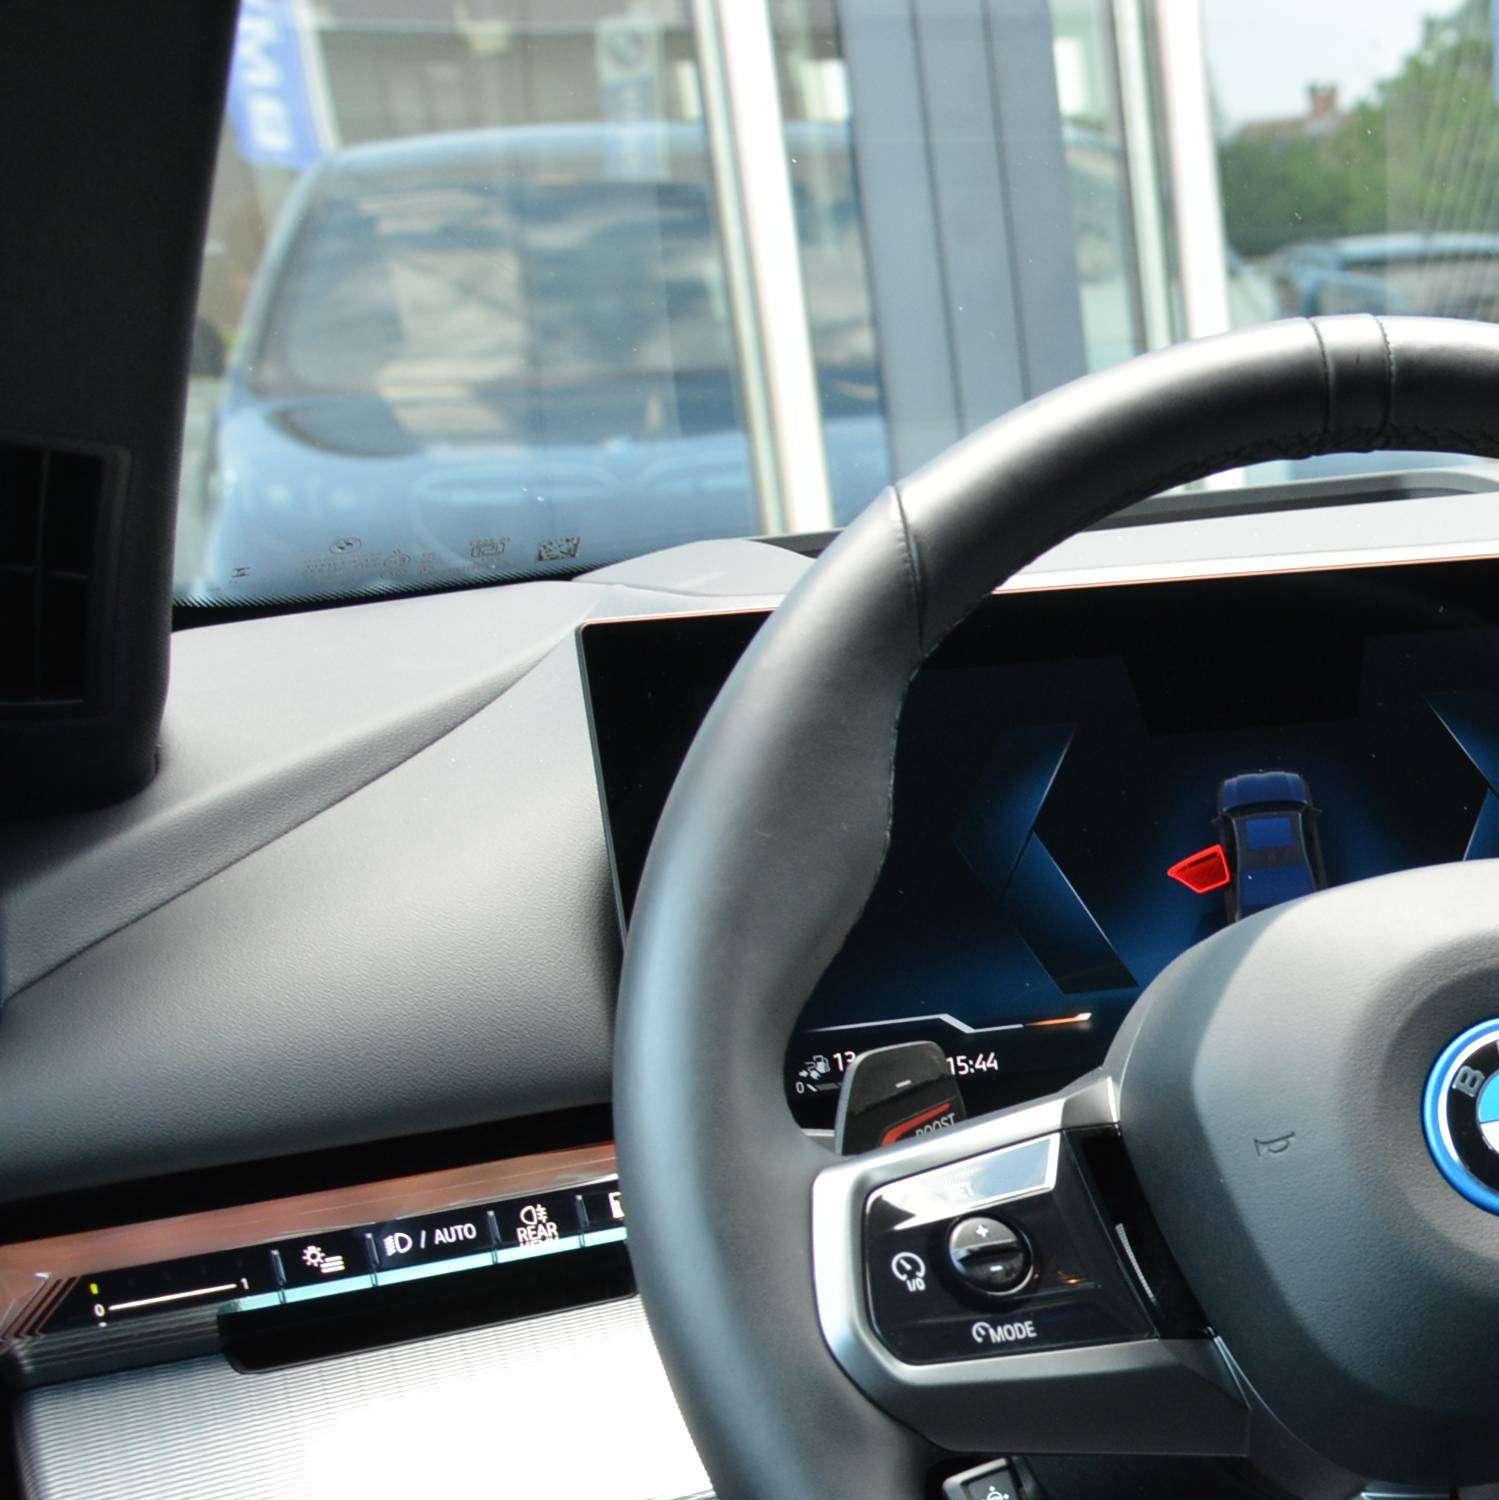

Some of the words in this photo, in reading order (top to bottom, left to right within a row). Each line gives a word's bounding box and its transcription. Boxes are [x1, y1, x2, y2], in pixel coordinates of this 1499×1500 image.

[946, 1052, 999, 1076] 15:44
[433, 1222, 477, 1246] AUTO
[516, 1222, 559, 1243] REAR
[988, 1320, 1038, 1344] MODE
